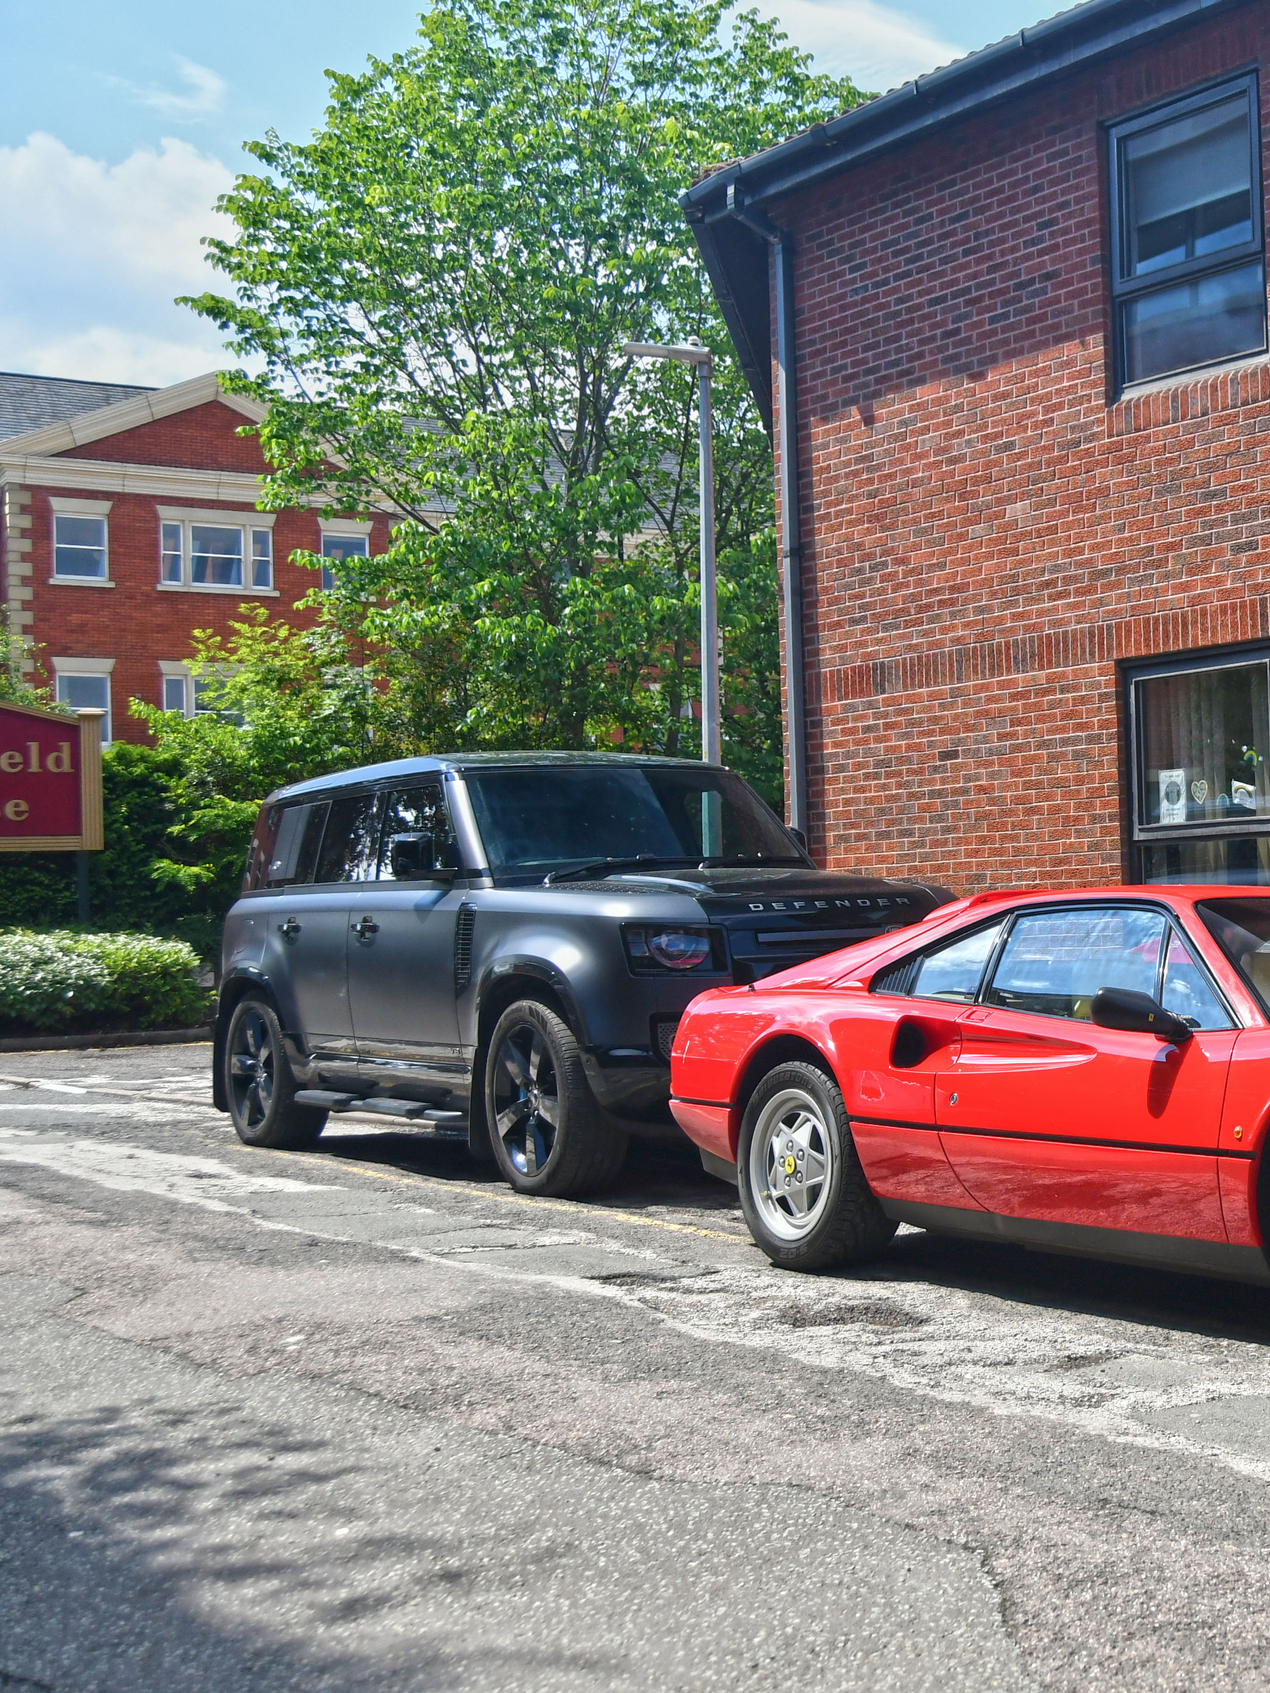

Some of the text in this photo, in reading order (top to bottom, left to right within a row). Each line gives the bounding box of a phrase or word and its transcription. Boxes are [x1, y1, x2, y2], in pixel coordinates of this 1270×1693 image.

[0, 742, 75, 773] eld
[0, 799, 30, 821] e
[749, 897, 911, 911] DEFENDER
